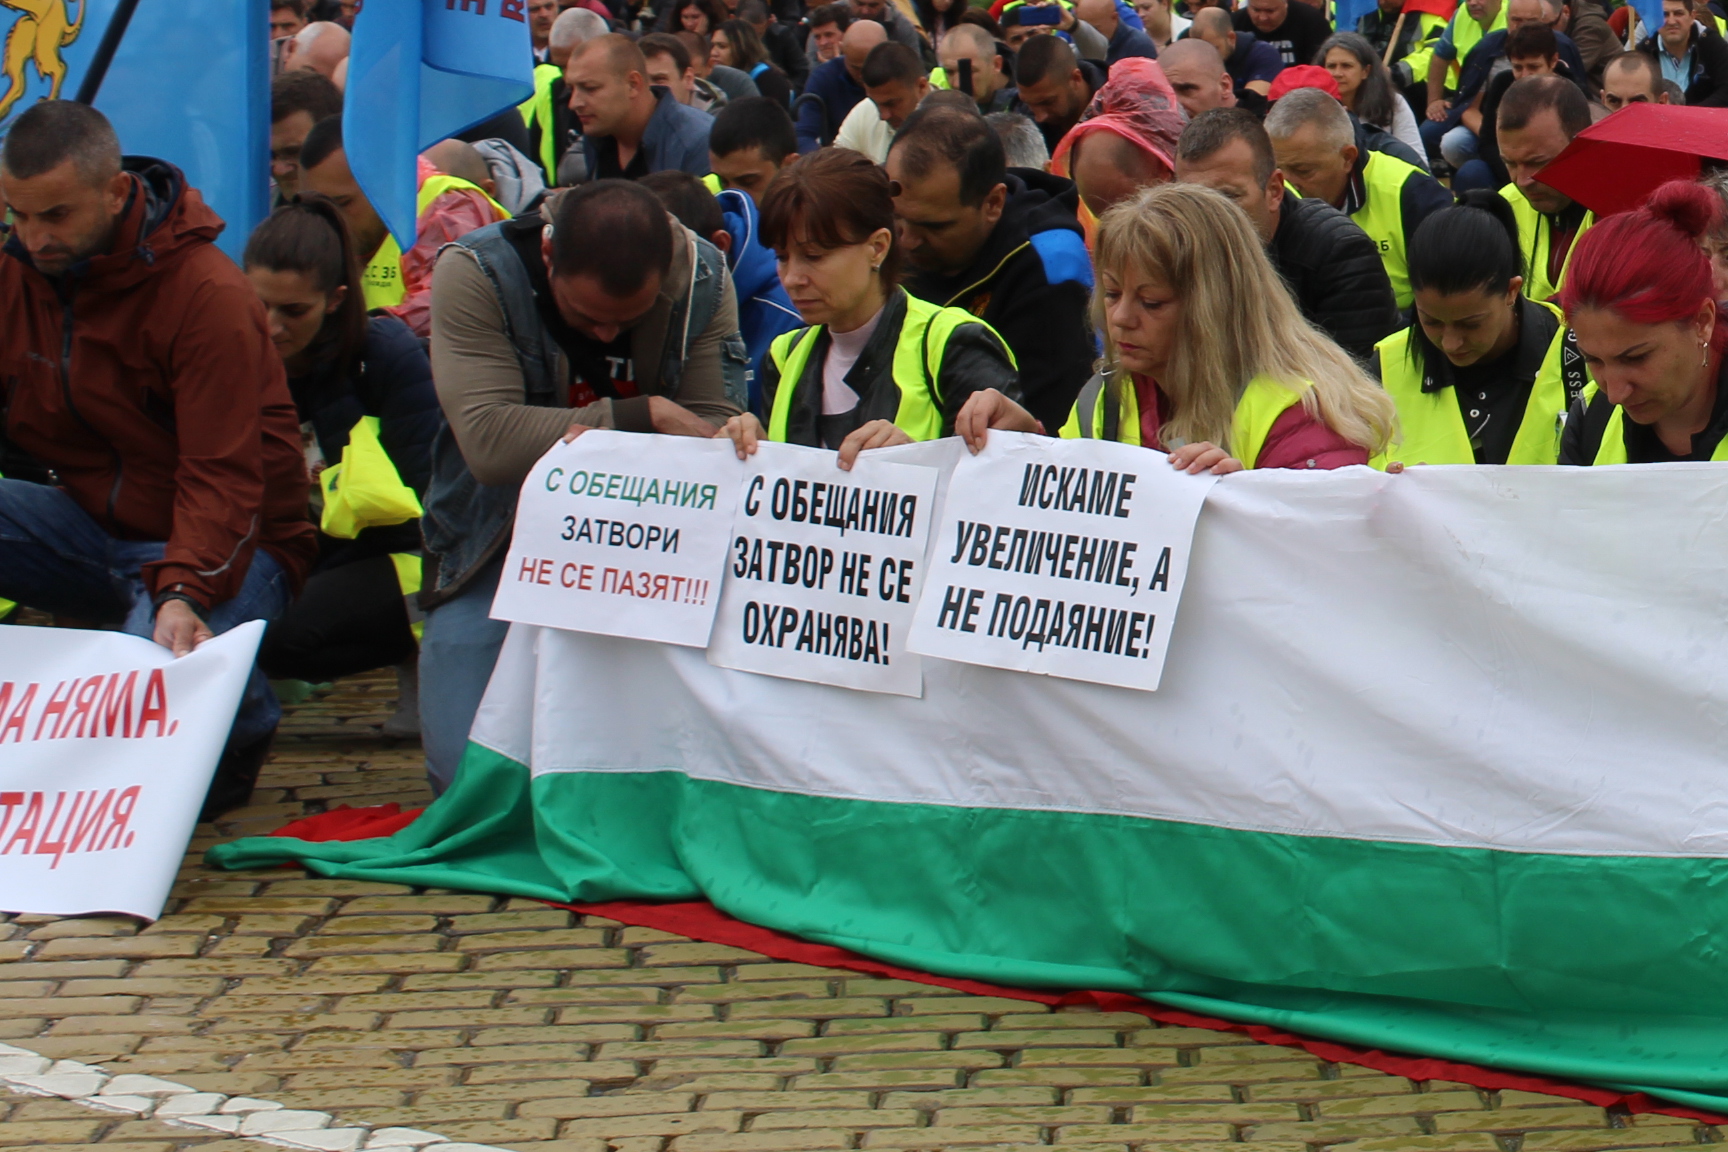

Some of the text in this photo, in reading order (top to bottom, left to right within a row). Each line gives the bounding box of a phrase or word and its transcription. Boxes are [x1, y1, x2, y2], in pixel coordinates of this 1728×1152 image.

[545, 467, 718, 510] С ОБЕЩАНИЯ
[745, 474, 918, 538] С ОБЕЩАНИЯ
[1017, 463, 1137, 518] ИСКАМЕ
[561, 515, 681, 554] ЗАТВОРИ
[950, 520, 1172, 597] УВЕЛИЧЕНИЕ, А
[517, 557, 710, 606] НЕ СЕ ПАЗЯТ!!!
[733, 536, 914, 604] ЗАТВОР НЕ СЕ
[742, 601, 890, 666] ОХРАНЯВА!
[937, 585, 1156, 659] НЕ ПОДАЯНИЕ!
[32, 668, 179, 741] НЯМА.
[0, 785, 142, 869] ТАЦИЯ.
